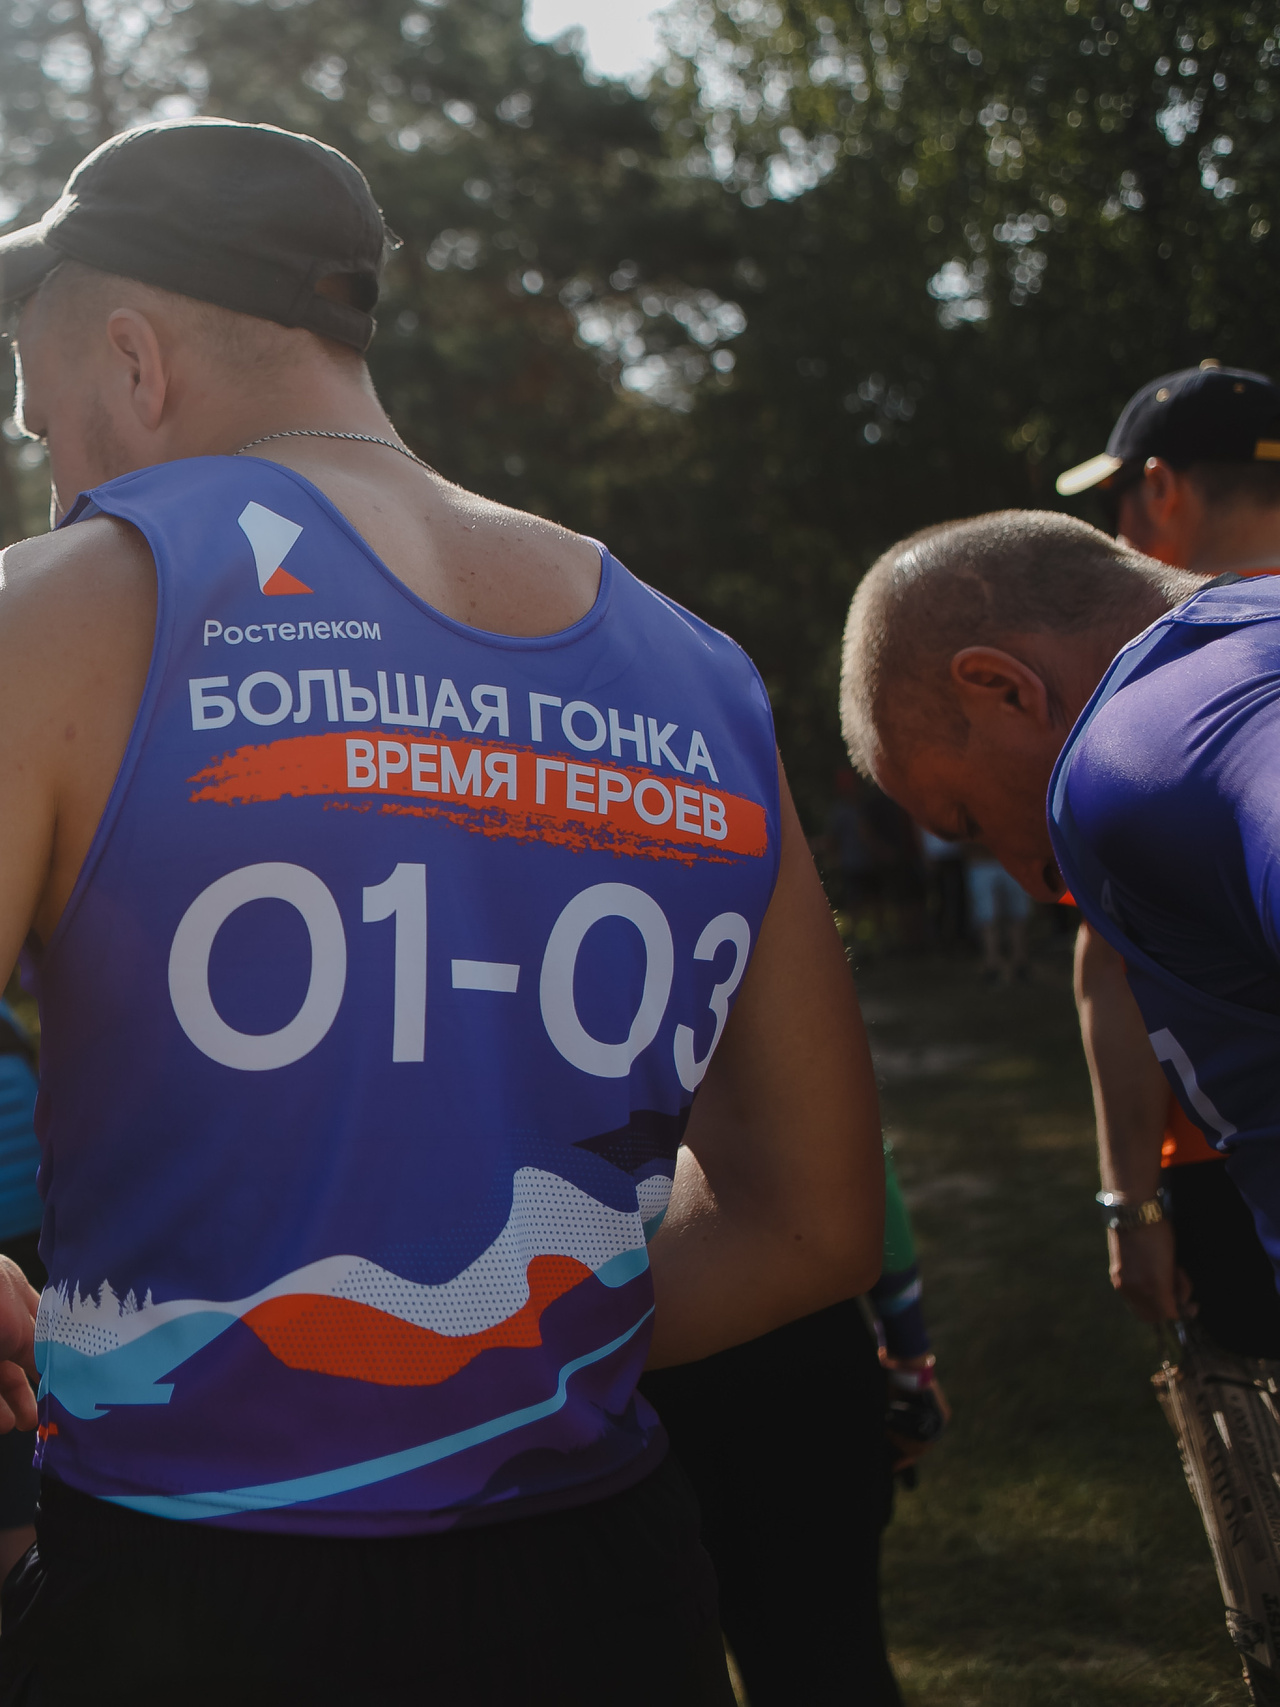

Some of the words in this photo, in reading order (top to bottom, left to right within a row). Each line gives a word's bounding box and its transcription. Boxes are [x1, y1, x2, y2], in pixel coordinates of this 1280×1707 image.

[202, 617, 382, 647] Ростелеком
[188, 668, 510, 738] БОЛЬШАЯ
[528, 691, 720, 784] ГОНКА
[345, 738, 518, 801] ВРЕМЯ
[535, 757, 729, 841] ГЕРОЕВ
[168, 861, 752, 1093] 01-03
